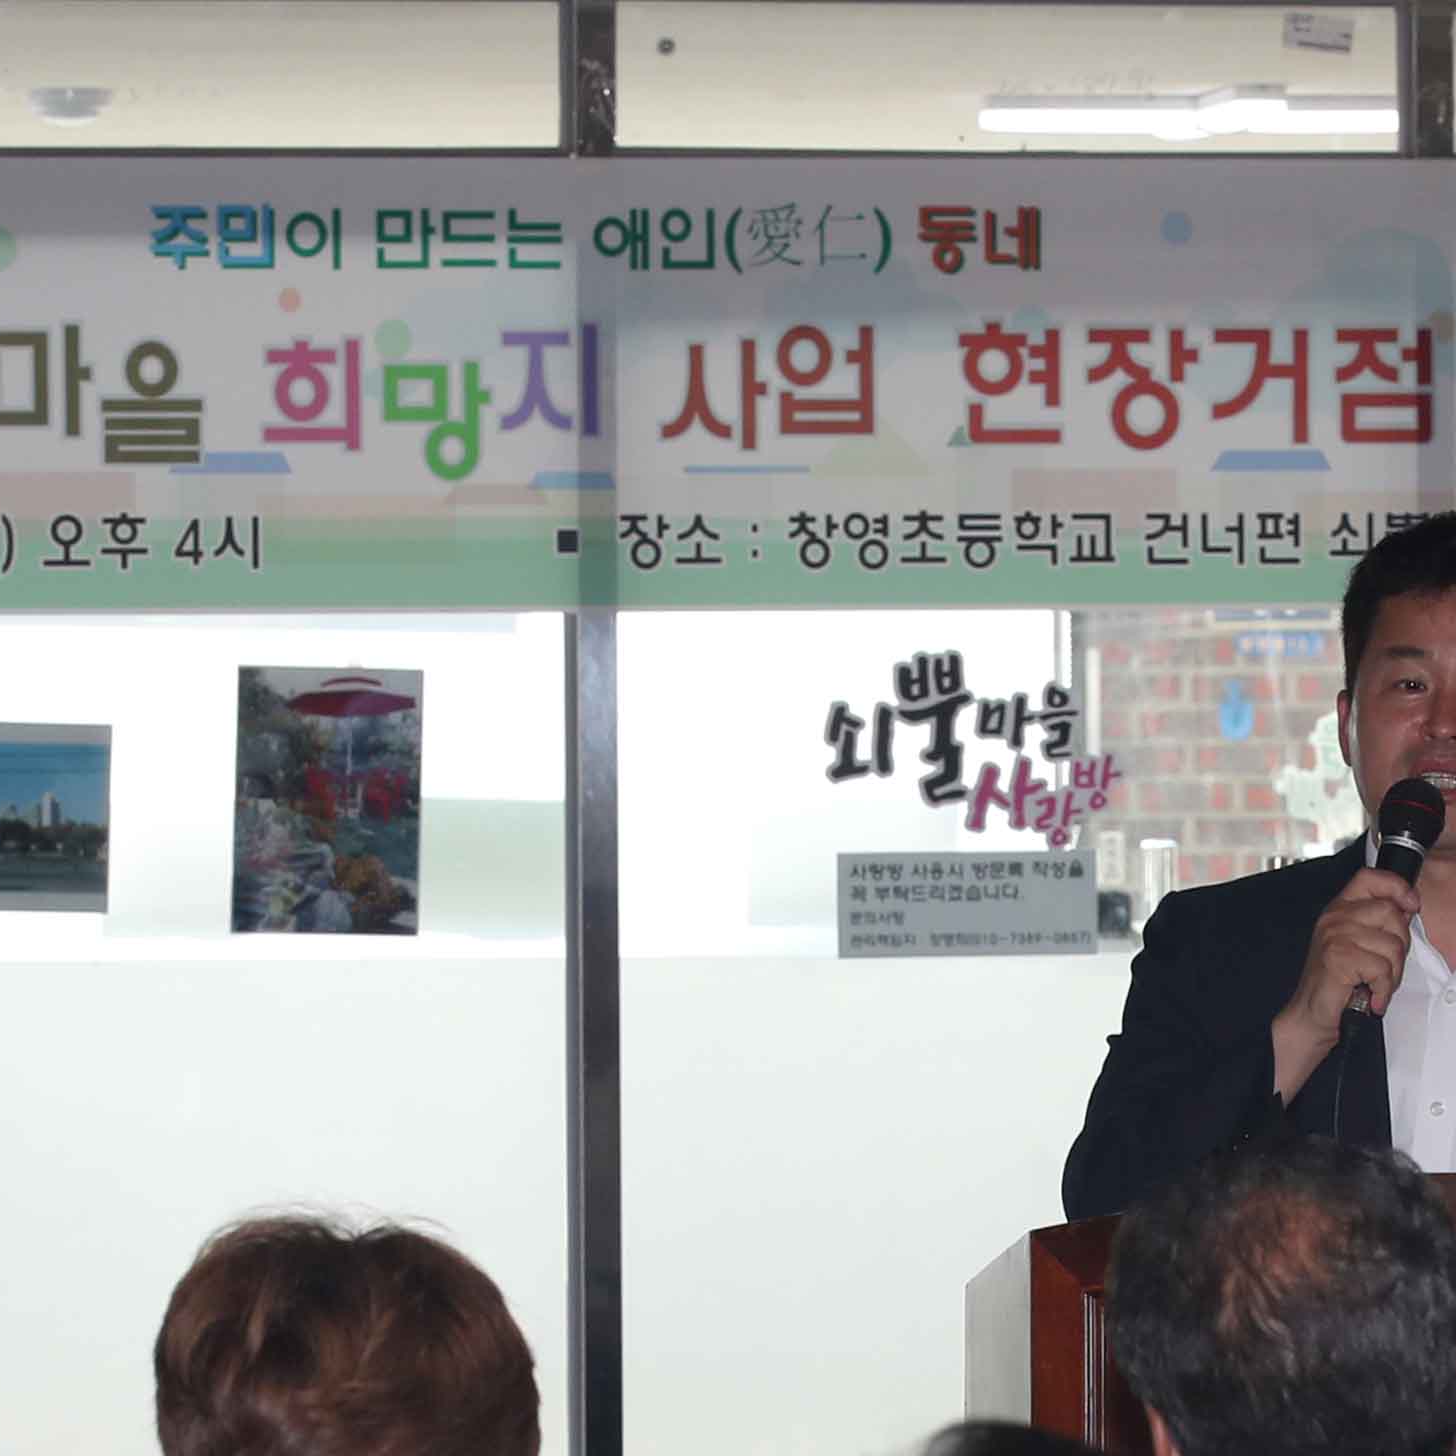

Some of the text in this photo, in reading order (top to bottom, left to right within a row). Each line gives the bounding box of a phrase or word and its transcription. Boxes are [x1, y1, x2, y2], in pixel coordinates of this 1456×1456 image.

[148, 203, 1043, 274] 주민이 만드는 애인(愛仁) 동네
[262, 323, 600, 483] 희망지
[660, 324, 875, 450] 사업
[959, 321, 1433, 450] 현장거점
[42, 513, 149, 571] 오후
[174, 514, 264, 571] 4시
[619, 513, 724, 570] 장소
[787, 510, 1115, 569] 창영초등학교
[1146, 511, 1302, 568] 건너편
[825, 650, 1080, 807] 쇠뿔마을
[966, 755, 1123, 847] 사랑방
[849, 862, 904, 881] 사랑방
